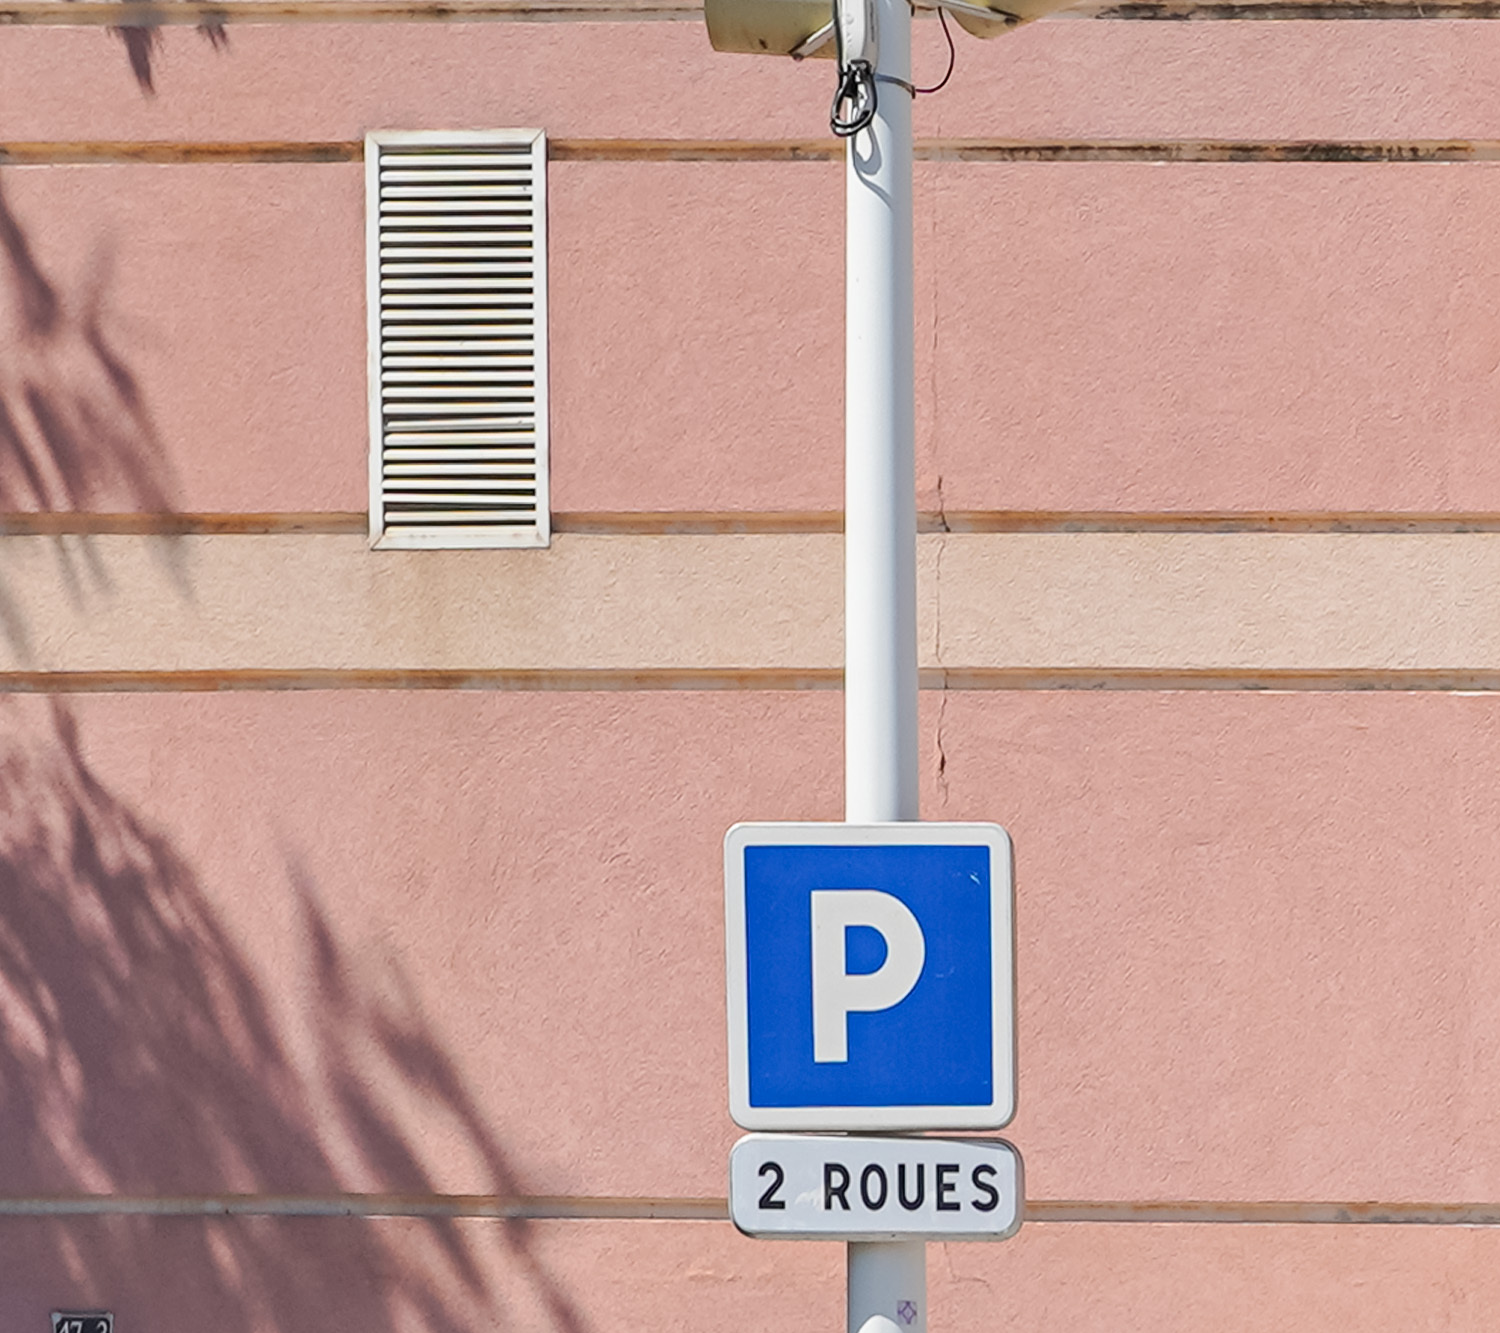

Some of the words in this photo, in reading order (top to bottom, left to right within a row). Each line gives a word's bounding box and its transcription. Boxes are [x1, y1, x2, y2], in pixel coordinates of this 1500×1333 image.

[811, 890, 926, 1063] P
[758, 1162, 786, 1210] 2
[823, 1163, 1000, 1212] ROUES
